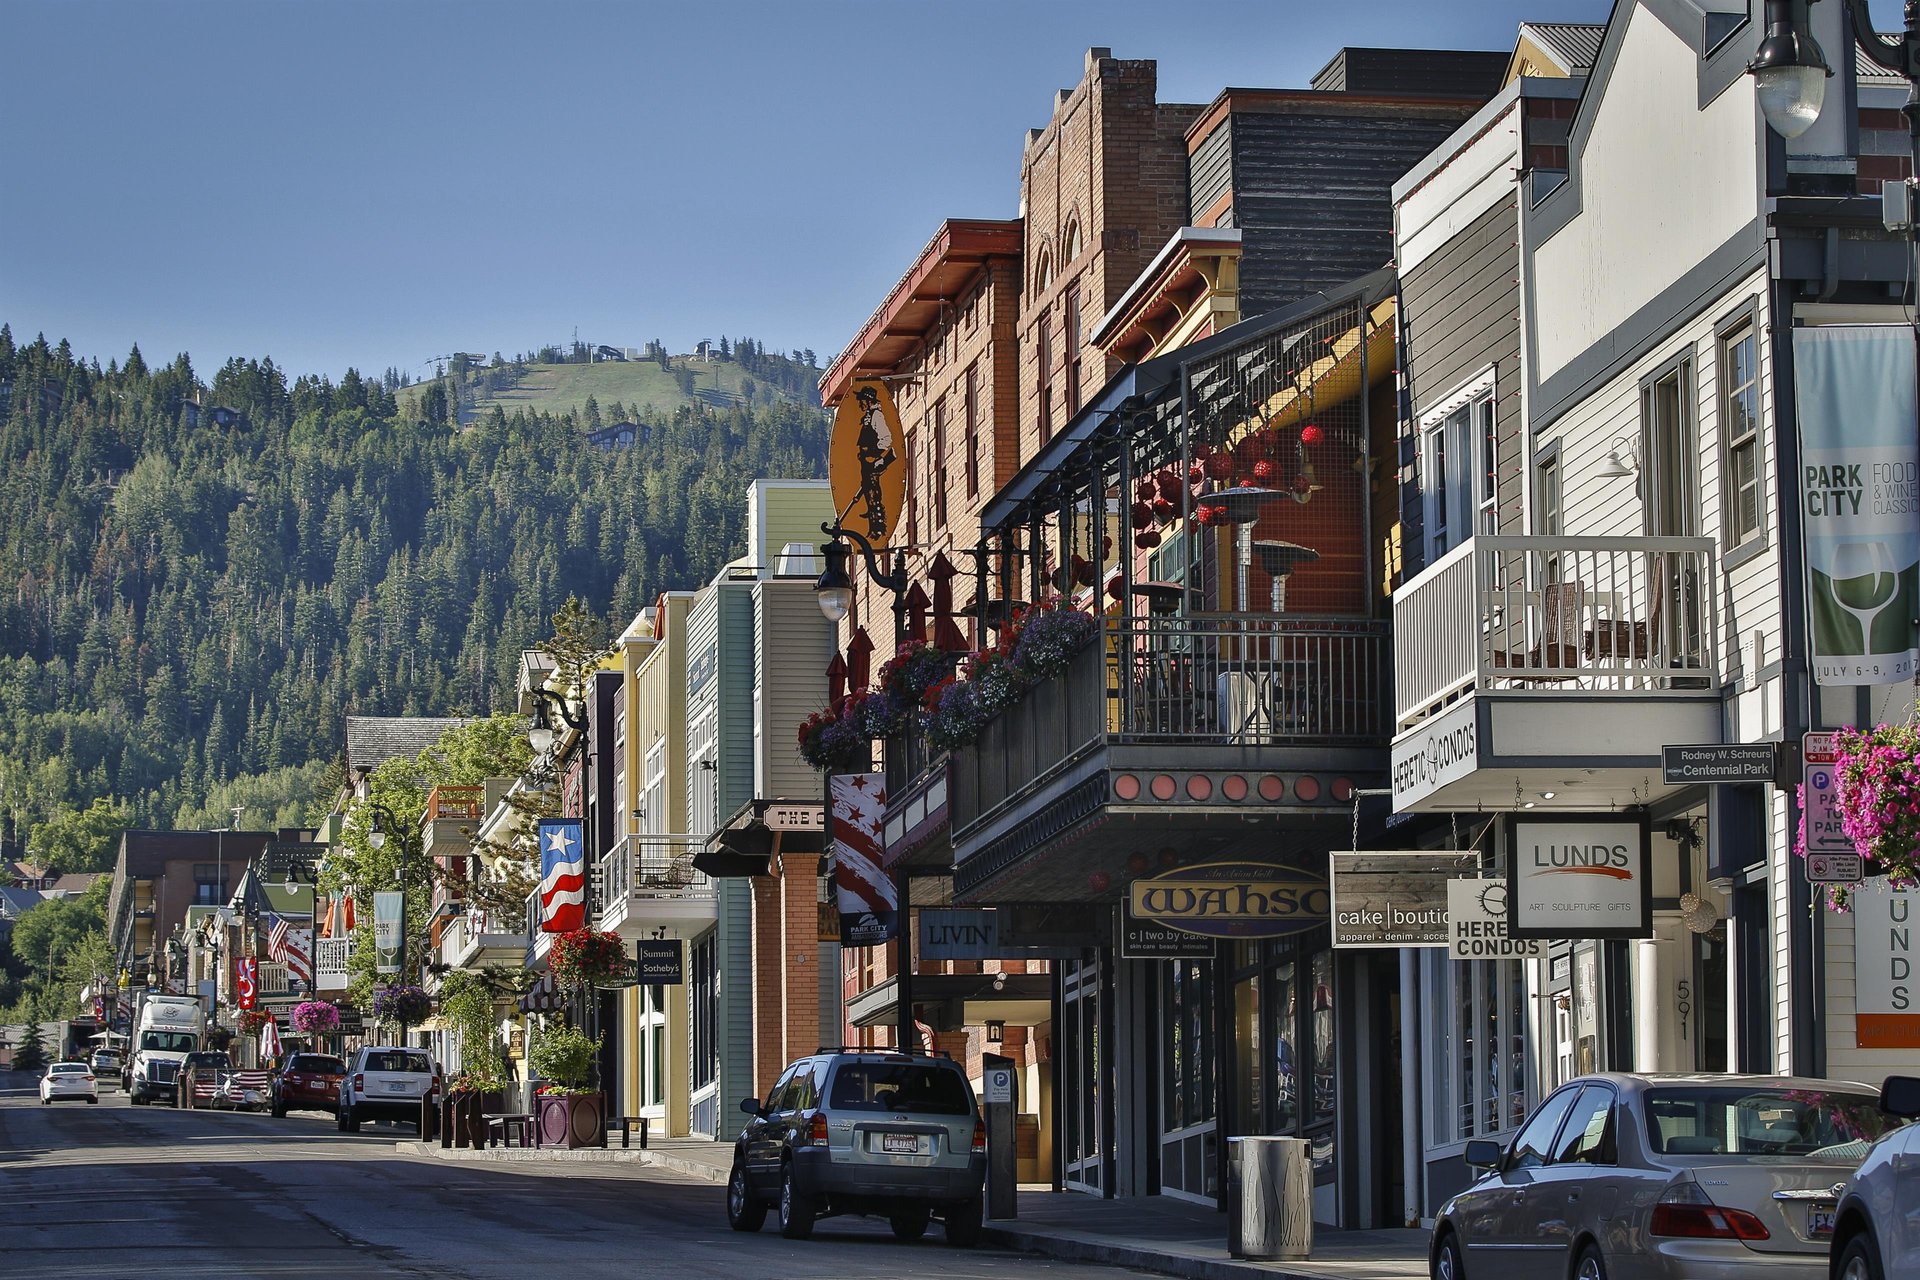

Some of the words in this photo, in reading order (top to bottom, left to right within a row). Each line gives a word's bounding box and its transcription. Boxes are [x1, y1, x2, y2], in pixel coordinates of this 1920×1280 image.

[1806, 464, 1863, 488] PARK
[1873, 462, 1917, 483] FOOD
[1874, 485, 1881, 499] &
[1885, 482, 1917, 498] WINE
[1807, 490, 1863, 516] CITY
[1873, 498, 1919, 515] CLASSIC
[1817, 666, 1847, 677] JULY
[1856, 665, 1886, 676] 6-9,
[1681, 750, 1716, 761] Rodney
[1717, 750, 1730, 760] W.
[1731, 749, 1771, 759] Schreurs
[1818, 745, 1828, 753] AM
[1393, 750, 1427, 796] HERETIC
[1438, 722, 1475, 770] CONDOS
[1682, 763, 1742, 776] Centennial
[1743, 763, 1769, 774] Park
[1819, 794, 1837, 805] PA
[777, 811, 810, 825] THE
[1815, 822, 1842, 833] PAR
[1534, 845, 1628, 867] LUNDS
[1528, 902, 1545, 911] ART
[1551, 902, 1601, 911] SCULPTURE
[1607, 902, 1631, 911] GIFTS
[1338, 908, 1383, 925] cake
[928, 924, 992, 945] LIVIN'
[1457, 921, 1508, 937] HERE
[1145, 931, 1165, 940] two
[1166, 931, 1180, 942] by
[1340, 933, 1375, 941] apparel
[1385, 932, 1413, 940] denim
[643, 949, 674, 958] Summit
[1159, 943, 1179, 951] beauty
[1457, 939, 1539, 955] CONDOS
[1889, 887, 1911, 1010] UNDS
[643, 963, 680, 974] Sotheby's
